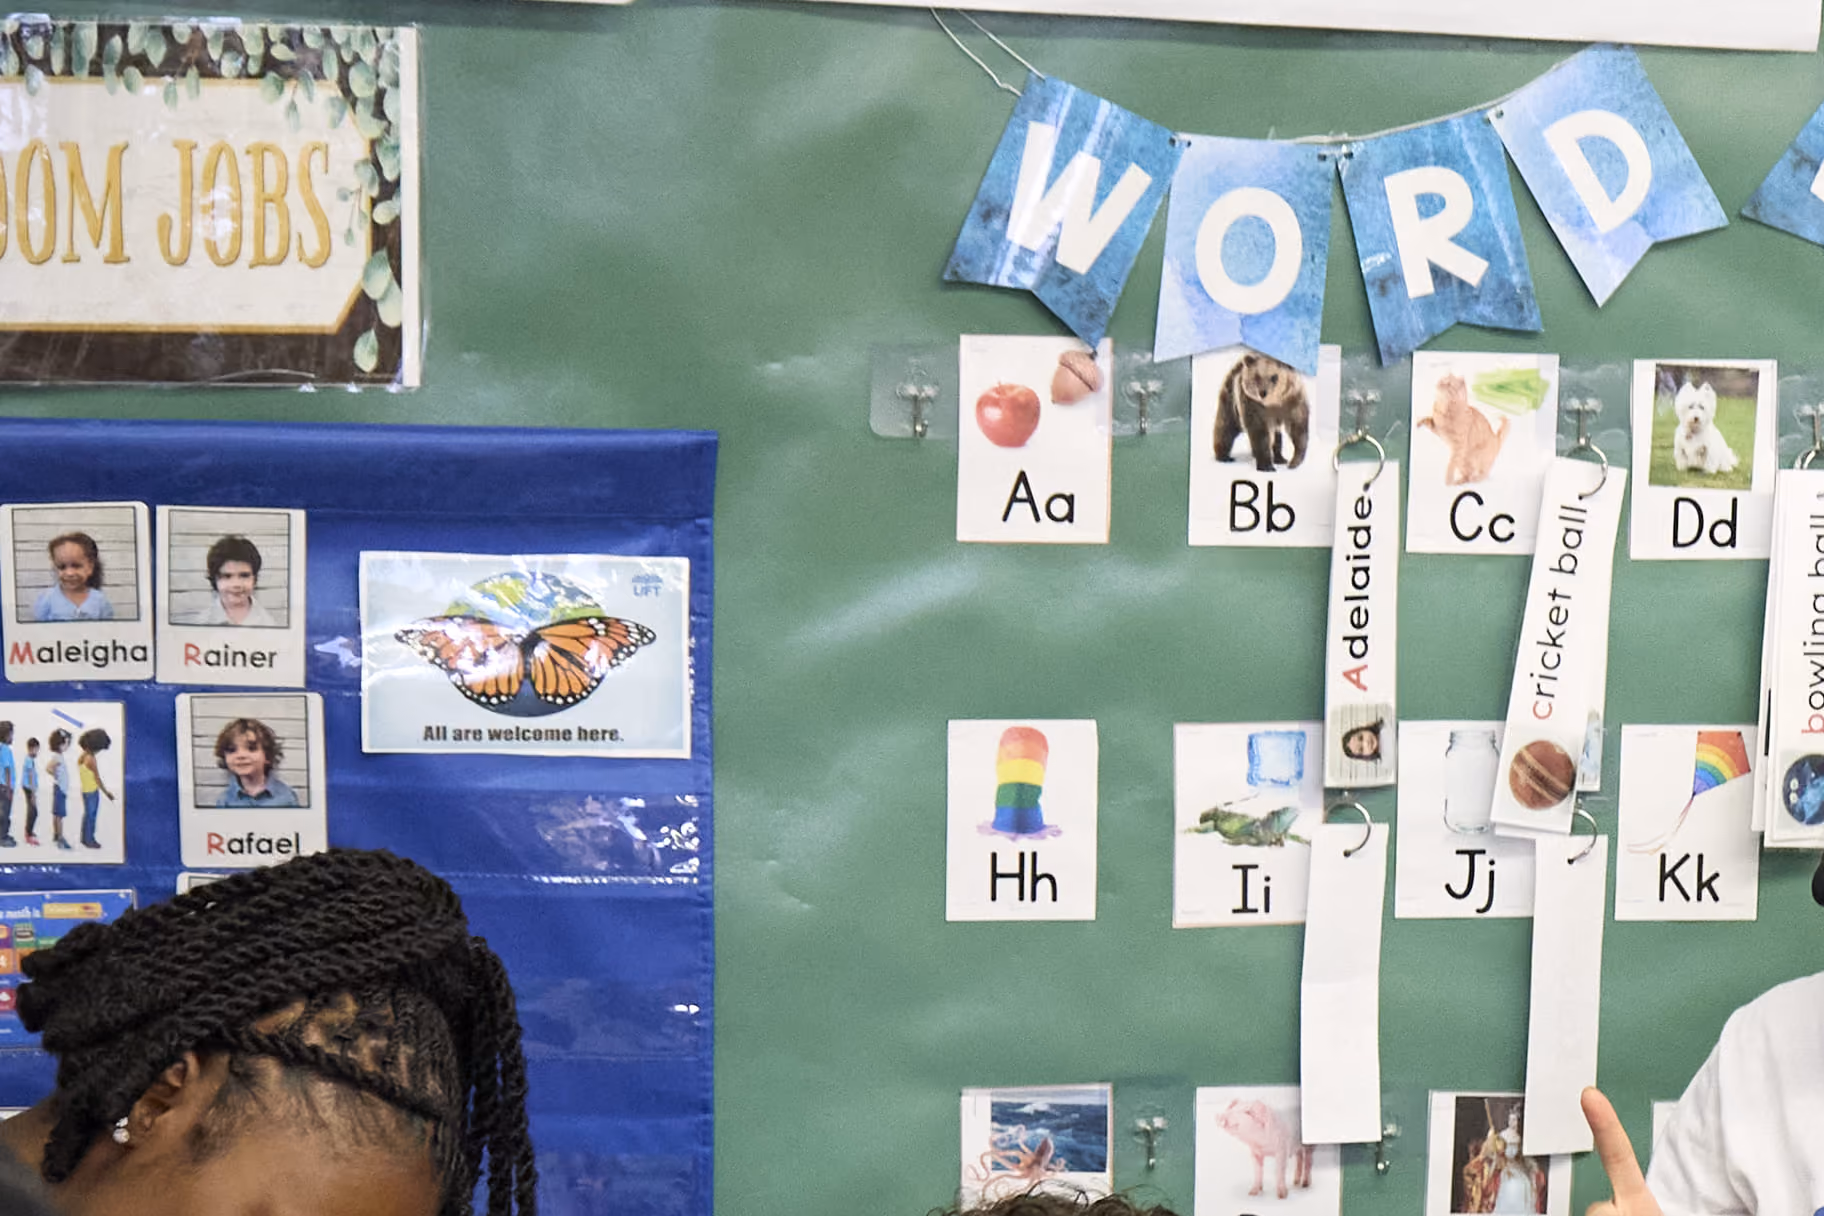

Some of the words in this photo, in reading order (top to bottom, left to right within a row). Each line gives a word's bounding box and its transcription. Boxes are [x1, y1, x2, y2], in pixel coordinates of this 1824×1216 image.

[157, 139, 332, 269] JOBS
[1006, 109, 1653, 315] WORD
[1002, 470, 1075, 524] Aa
[1229, 479, 1296, 533] Bb
[1449, 490, 1515, 543] Cc
[1672, 496, 1738, 549] Dd
[1548, 504, 1588, 577] ball
[1342, 495, 1373, 692] Adelaide
[8, 638, 149, 669] Maleigha
[184, 642, 278, 669] Rainer
[1530, 588, 1573, 720] cricket
[423, 725, 448, 742] All
[452, 727, 483, 742] are
[487, 725, 573, 742] welcome
[577, 725, 625, 742] here.
[206, 832, 301, 856] Rafael
[990, 851, 1058, 903] Hh
[1231, 864, 1271, 914] Ii
[1444, 849, 1497, 914] Jj
[1658, 852, 1720, 903] Kk
